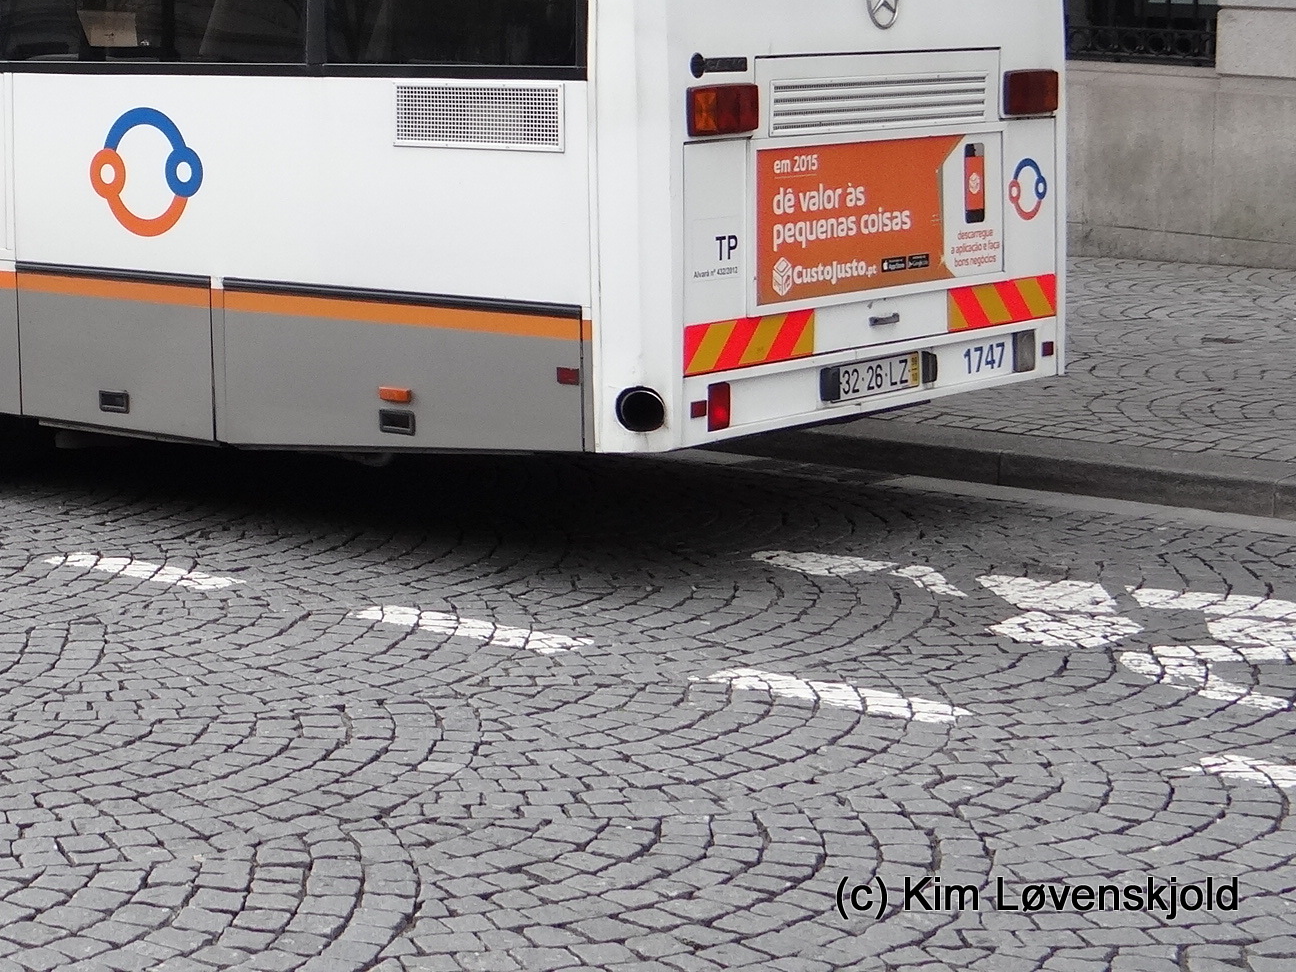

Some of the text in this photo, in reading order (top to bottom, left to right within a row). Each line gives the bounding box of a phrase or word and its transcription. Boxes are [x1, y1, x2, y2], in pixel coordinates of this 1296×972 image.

[773, 154, 819, 174] em 2015
[772, 182, 866, 215] dê valor às
[772, 206, 911, 252] pequenas coisas
[956, 229, 994, 240] descarregue
[715, 235, 738, 261] TP
[955, 242, 983, 256] aplicação
[793, 259, 878, 285] CustoJusto.pt
[954, 254, 997, 267] bons negócios
[693, 270, 710, 279] Alvará
[963, 341, 1005, 375] 1747
